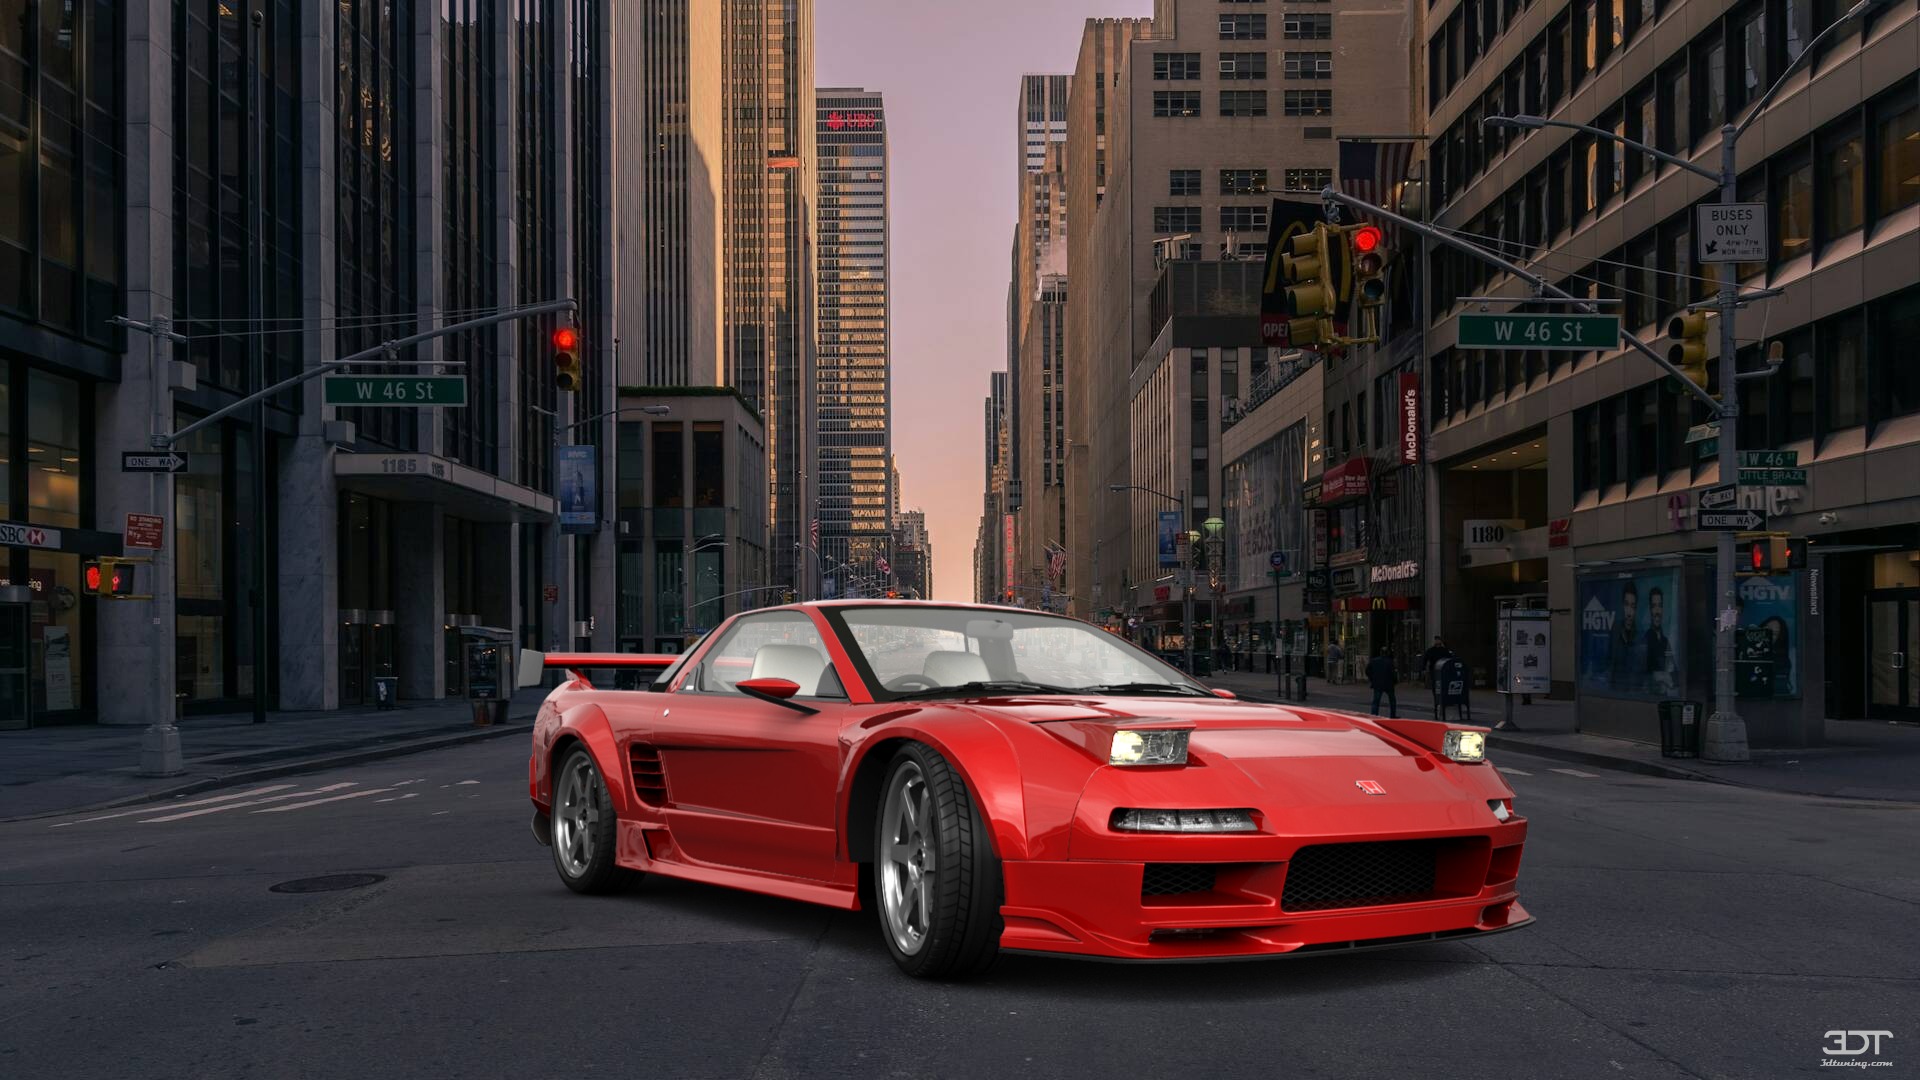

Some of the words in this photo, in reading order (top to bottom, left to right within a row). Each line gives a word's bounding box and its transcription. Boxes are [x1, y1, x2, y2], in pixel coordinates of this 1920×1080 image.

[1712, 209, 1753, 221] BUSES
[1716, 225, 1748, 236] ONLY
[1263, 322, 1288, 337] OPE
[1494, 321, 1514, 342] W
[1524, 321, 1551, 342] 46
[1561, 321, 1583, 342] St
[356, 382, 374, 400] W
[383, 382, 406, 400] 46
[415, 381, 434, 400] St
[1405, 389, 1417, 461] McDonald's
[131, 458, 149, 466] ONE
[159, 458, 178, 466] WAY
[381, 459, 417, 473] 1185
[1749, 453, 1760, 466] W
[1766, 453, 1784, 466] 46
[1739, 470, 1769, 481] LITTLE
[1771, 470, 1805, 481] BRAZIL
[1708, 517, 1727, 525] ONE
[1737, 517, 1756, 525] WAY
[0, 527, 26, 544] SBC
[1472, 526, 1504, 543] 1180
[1371, 560, 1418, 583] McDonald's
[1740, 585, 1792, 600] HGTV
[1583, 610, 1616, 631] HGTV
